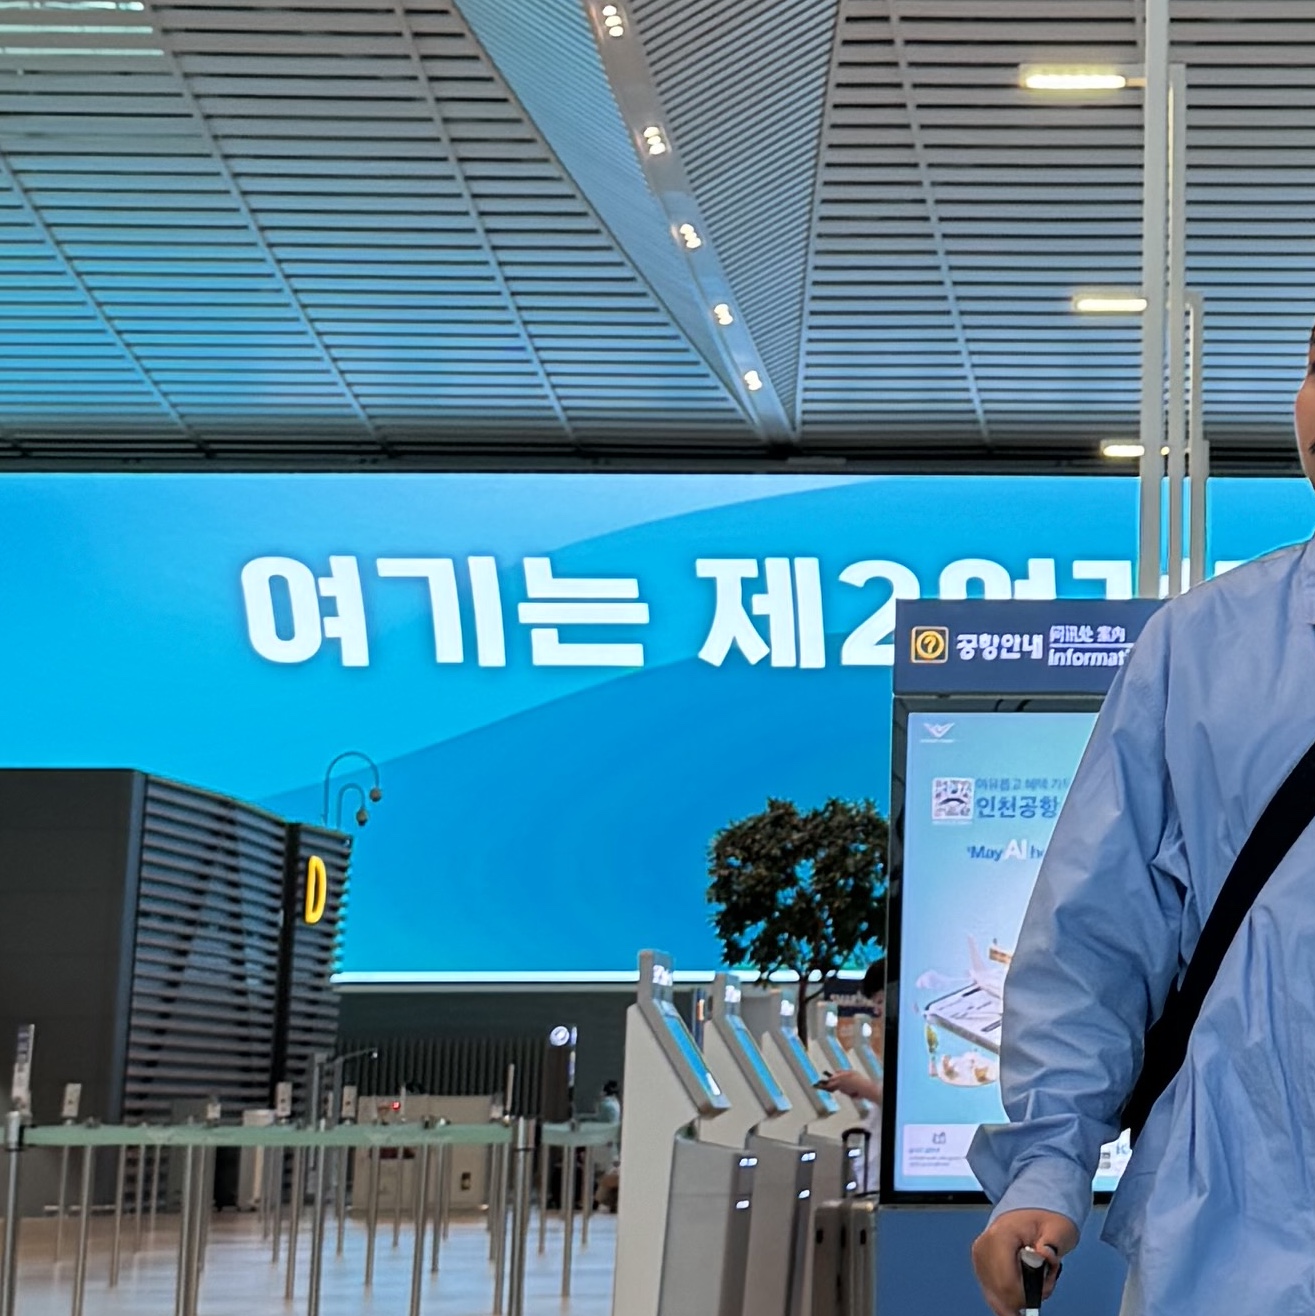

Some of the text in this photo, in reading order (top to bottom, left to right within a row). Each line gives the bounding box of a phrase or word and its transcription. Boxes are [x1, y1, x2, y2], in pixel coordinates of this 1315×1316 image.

[240, 555, 650, 668] 여기는
[956, 633, 1044, 661] 공항안내
[976, 795, 1058, 819] 인천공항
[1004, 838, 1028, 860] AI
[304, 854, 327, 924] D
